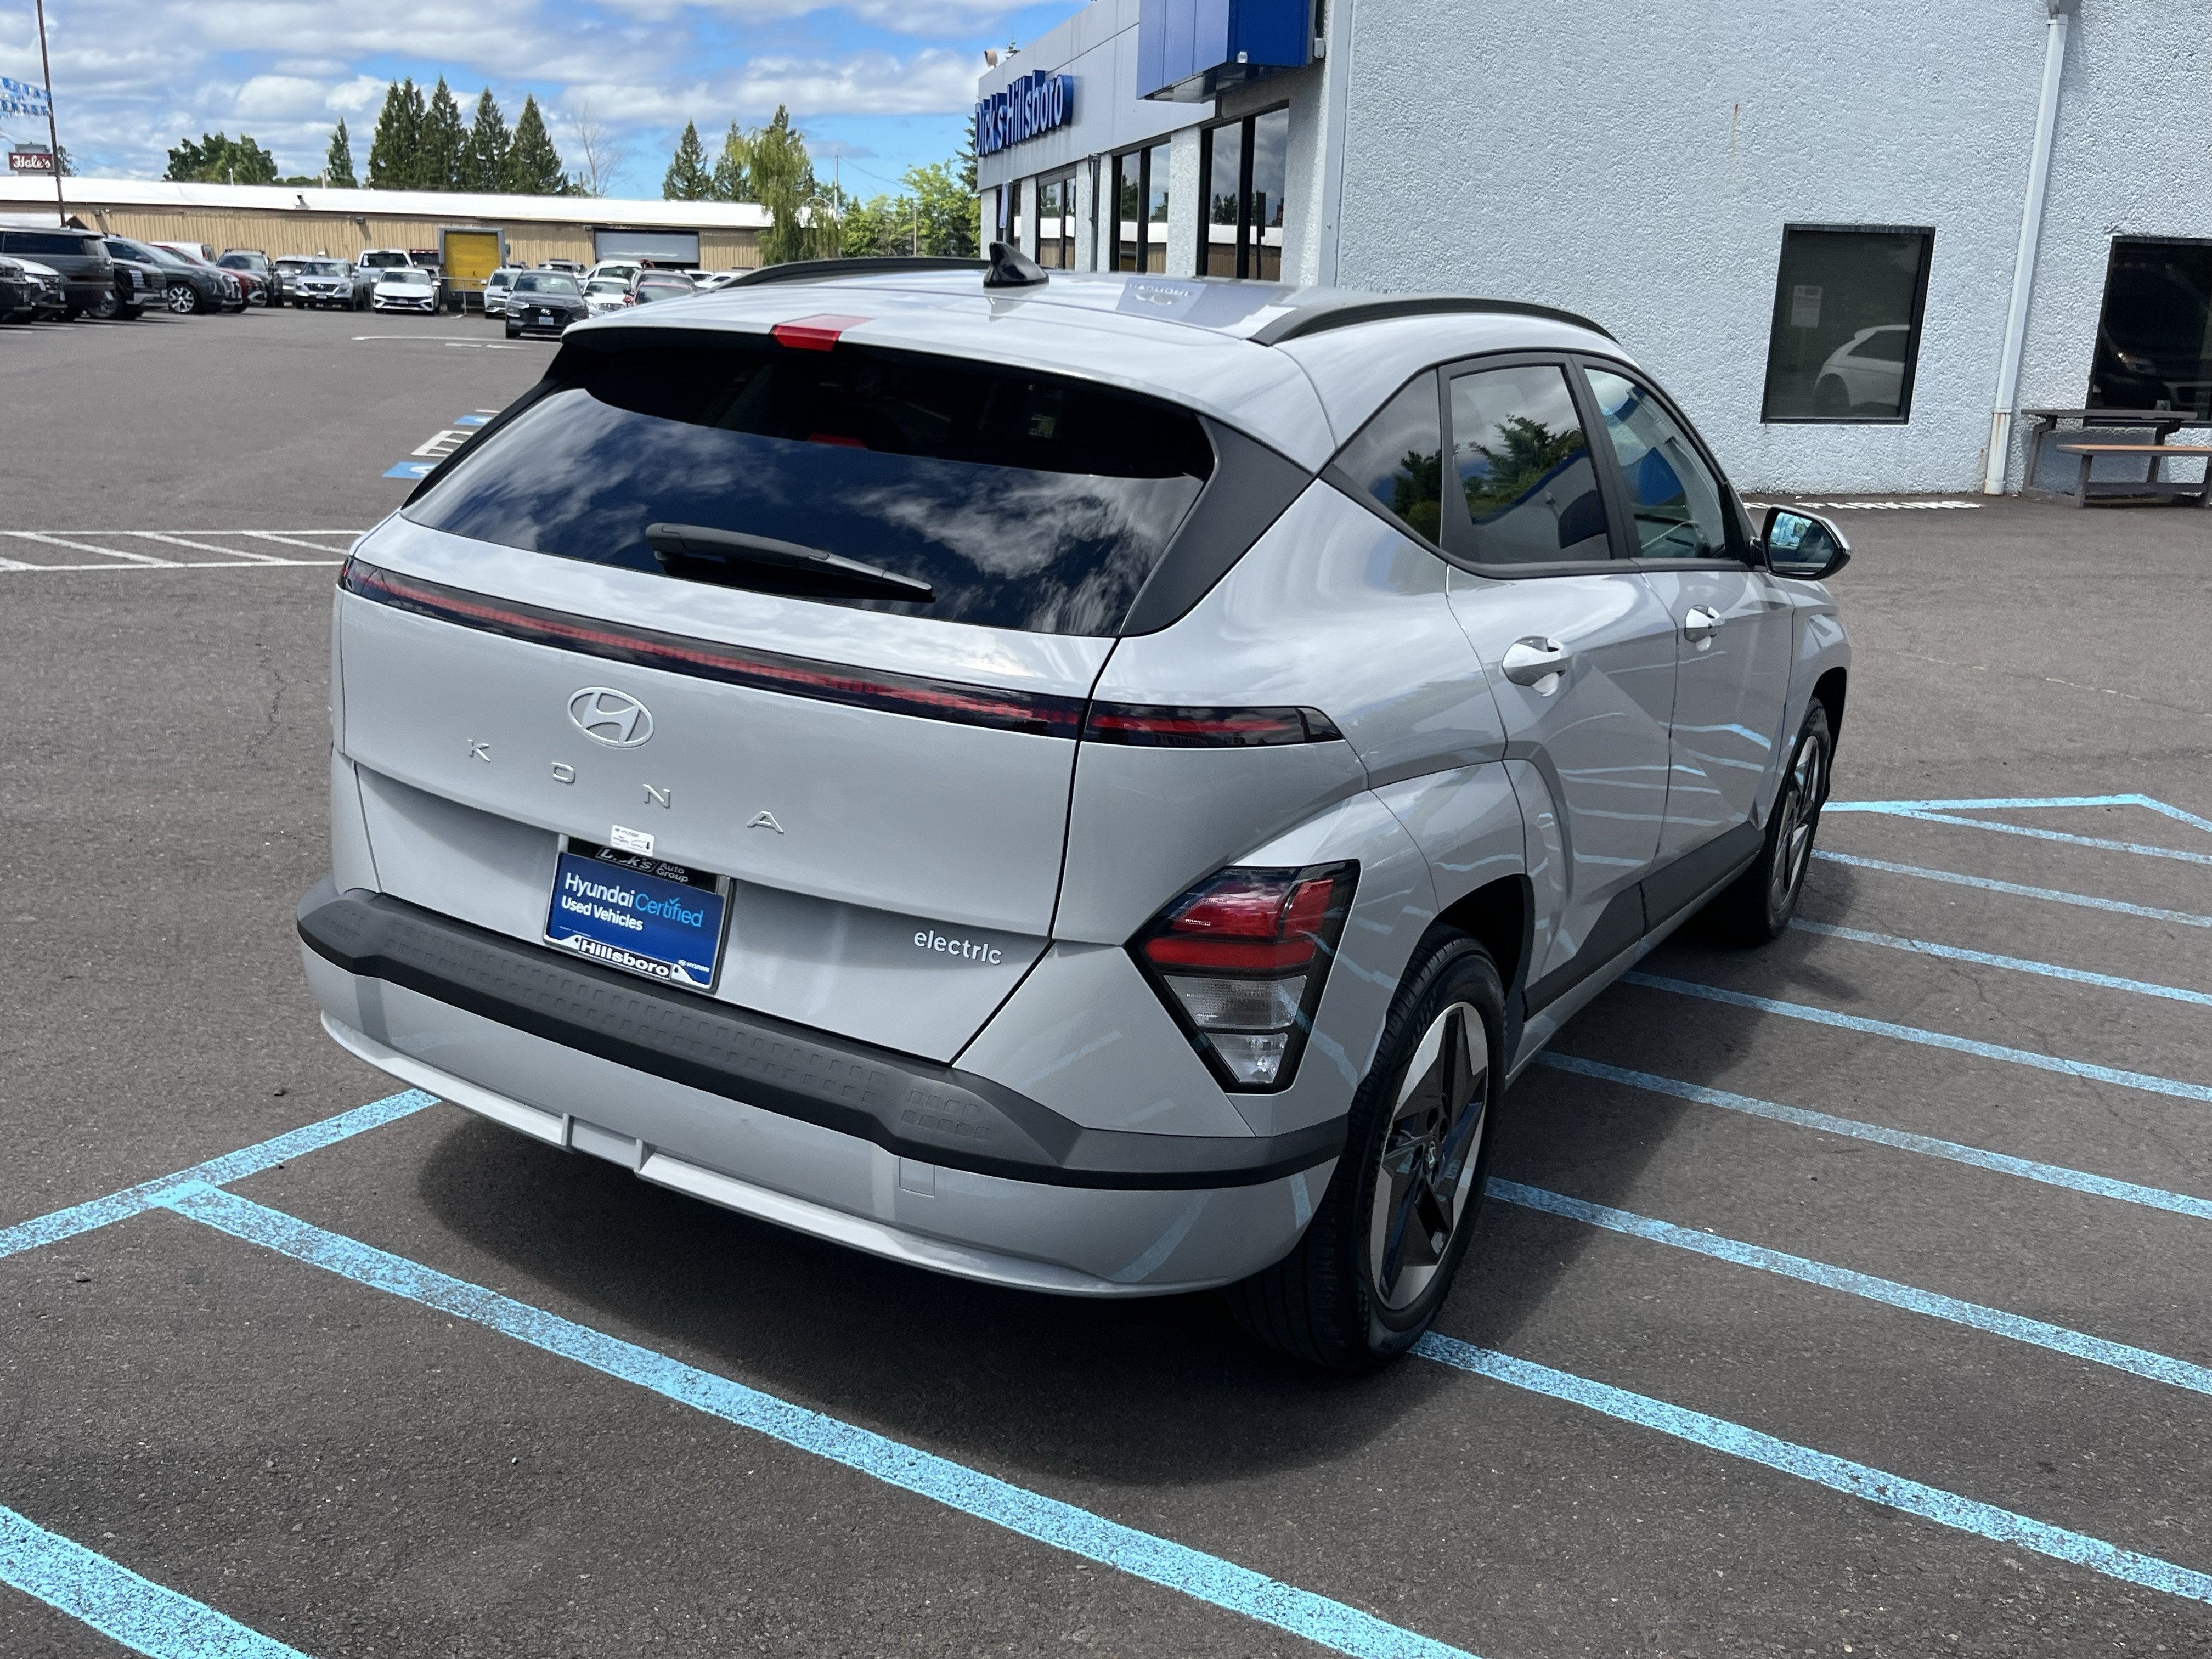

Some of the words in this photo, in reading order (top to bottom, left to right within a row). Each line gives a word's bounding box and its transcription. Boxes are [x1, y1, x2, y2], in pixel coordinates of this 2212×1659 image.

[975, 92, 1005, 157] Dick's
[1006, 70, 1066, 145] Hillsboro
[13, 155, 51, 168] Hale's
[656, 868, 689, 883] Group
[659, 862, 685, 874] Auto
[561, 895, 591, 916] Used
[593, 902, 644, 931] Vehicles
[565, 873, 635, 908] Hyundai
[635, 893, 704, 928] Certified
[581, 940, 669, 976] Hillsboro
[914, 930, 1002, 964] electric
